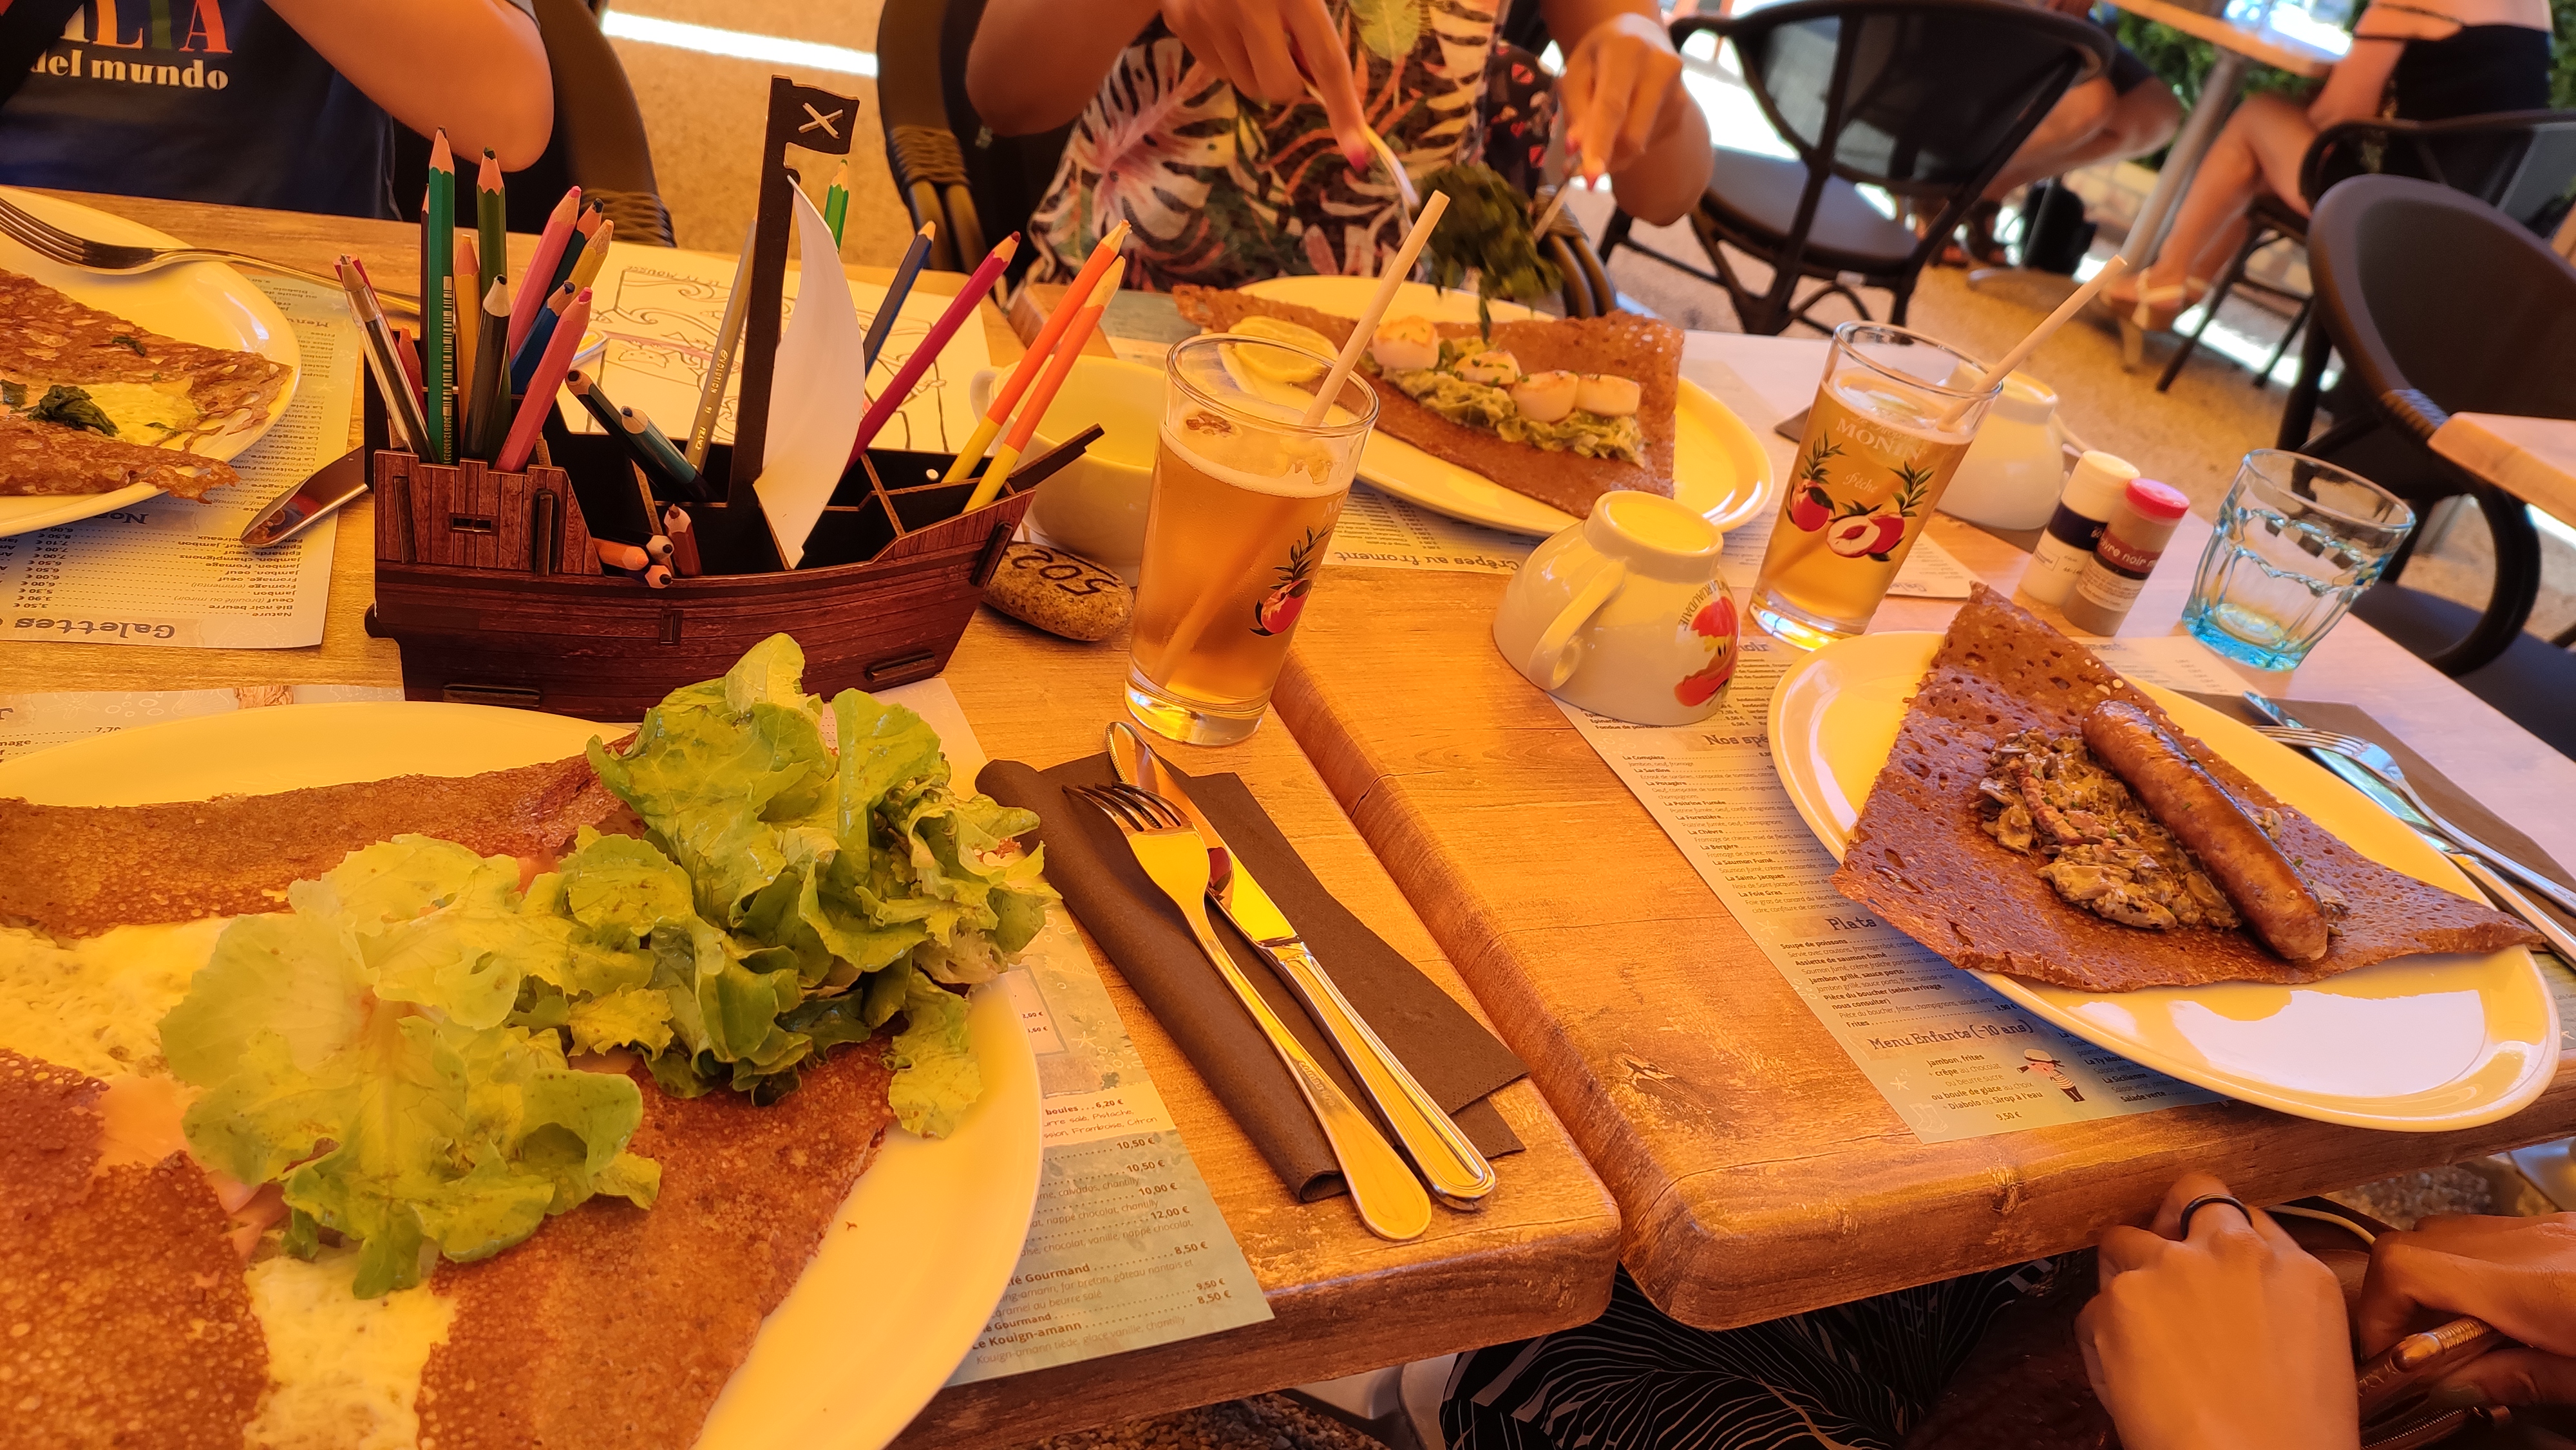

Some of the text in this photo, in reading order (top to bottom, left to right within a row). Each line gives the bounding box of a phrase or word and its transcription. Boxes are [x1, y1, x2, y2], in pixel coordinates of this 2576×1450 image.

[91, 59, 229, 90] mundo
[1835, 417, 1924, 461] MONIN
[1333, 551, 1421, 566] froment
[1453, 555, 1520, 571] Crêpes
[14, 617, 175, 639] Galettes
[1701, 734, 1740, 746] Nos
[1824, 916, 1877, 931] Plats
[1815, 939, 1848, 948] poissons
[1808, 975, 1840, 985] Jambon
[1839, 972, 1862, 982] grillé,
[1883, 969, 1905, 977] porto
[1855, 989, 1888, 997] boucher
[1887, 986, 1913, 995] (selon
[1851, 997, 1891, 1008] consulter)
[1866, 1019, 2034, 1050] Menu Enfants (-10 ans)
[1926, 1054, 1985, 1068] Jambon, frites
[1935, 1068, 1959, 1077] crêpe
[1969, 1063, 2002, 1072] chocolat
[2111, 1073, 2148, 1082] Sicilienne
[1954, 1077, 1984, 1086] beurre
[1942, 1089, 1969, 1098] boule
[1980, 1086, 2003, 1095] glace
[2120, 1093, 2147, 1102] Salade
[1045, 1106, 1079, 1115] boules
[1095, 1100, 1115, 1109] 6,20
[1947, 1099, 1982, 1110] Diabolo
[1092, 1109, 1132, 1120] Pistache,
[1995, 1112, 2015, 1121] 9,50
[1071, 1116, 1158, 1135] Framboise, Citron
[1116, 1138, 1146, 1149] 10,50
[1126, 1159, 1166, 1172] 10,50 €
[1058, 1176, 1140, 1197] calvados, chantilly
[1138, 1183, 1168, 1196] 10,00
[1046, 1198, 1159, 1225] nappé chocolat, chantilly
[1150, 1205, 1190, 1220] 12,00 €
[1043, 1219, 1194, 1253] chocolat, vanille, nappé chocolat,
[1025, 1241, 1208, 1283] Gourmand 8,50 €
[1077, 1276, 1112, 1289] breton,
[1148, 1261, 1182, 1274] nantais
[1184, 1259, 1193, 1267] et
[994, 1312, 1052, 1331] Gourmand
[1196, 1279, 1217, 1290] 9,50
[1033, 1288, 1103, 1311] au beurre salé
[988, 1323, 1082, 1347] Kouign-amann
[1197, 1292, 1222, 1304] 8,50
[1224, 1290, 1231, 1298] €
